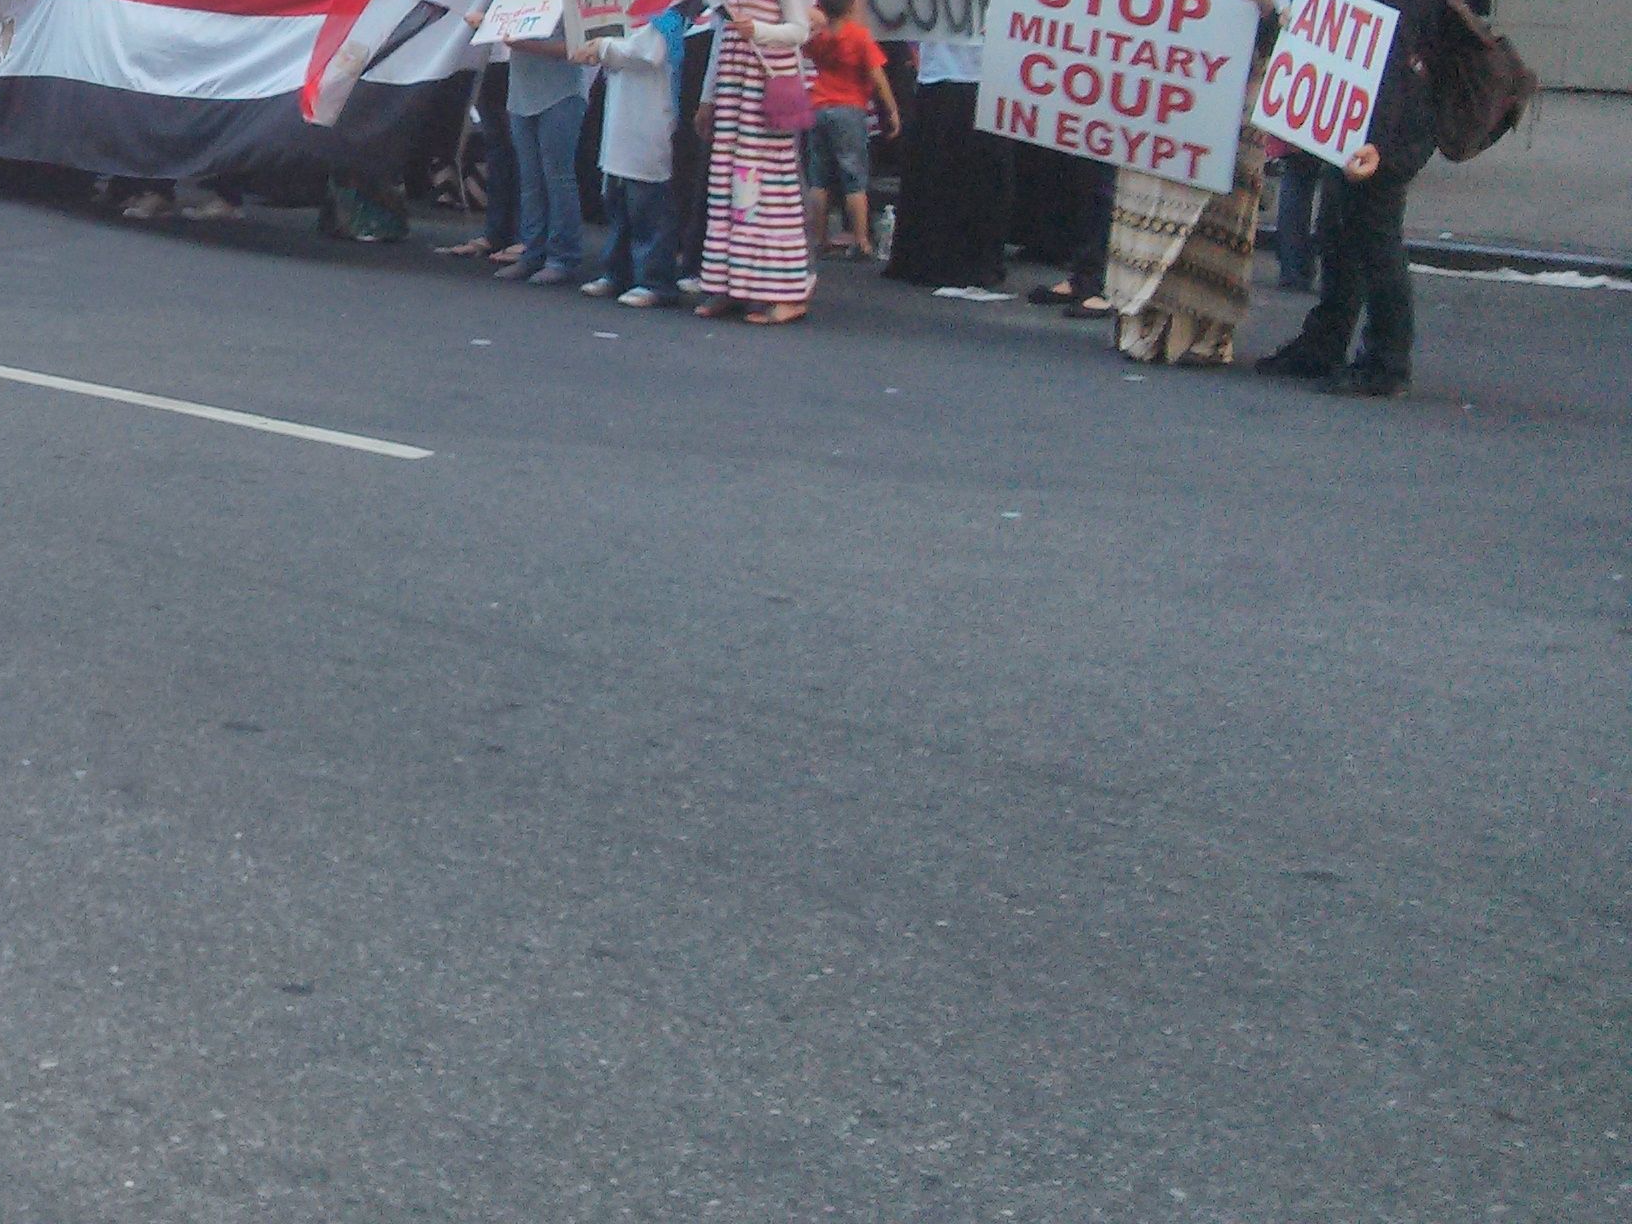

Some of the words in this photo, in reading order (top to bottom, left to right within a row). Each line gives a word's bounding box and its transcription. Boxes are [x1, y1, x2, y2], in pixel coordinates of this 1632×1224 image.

[1008, 11, 1231, 83] MILITARY
[1019, 52, 1196, 124] COUP
[1261, 50, 1369, 154] COUP
[994, 96, 1040, 138] IN
[1054, 110, 1210, 179] EGYPT
